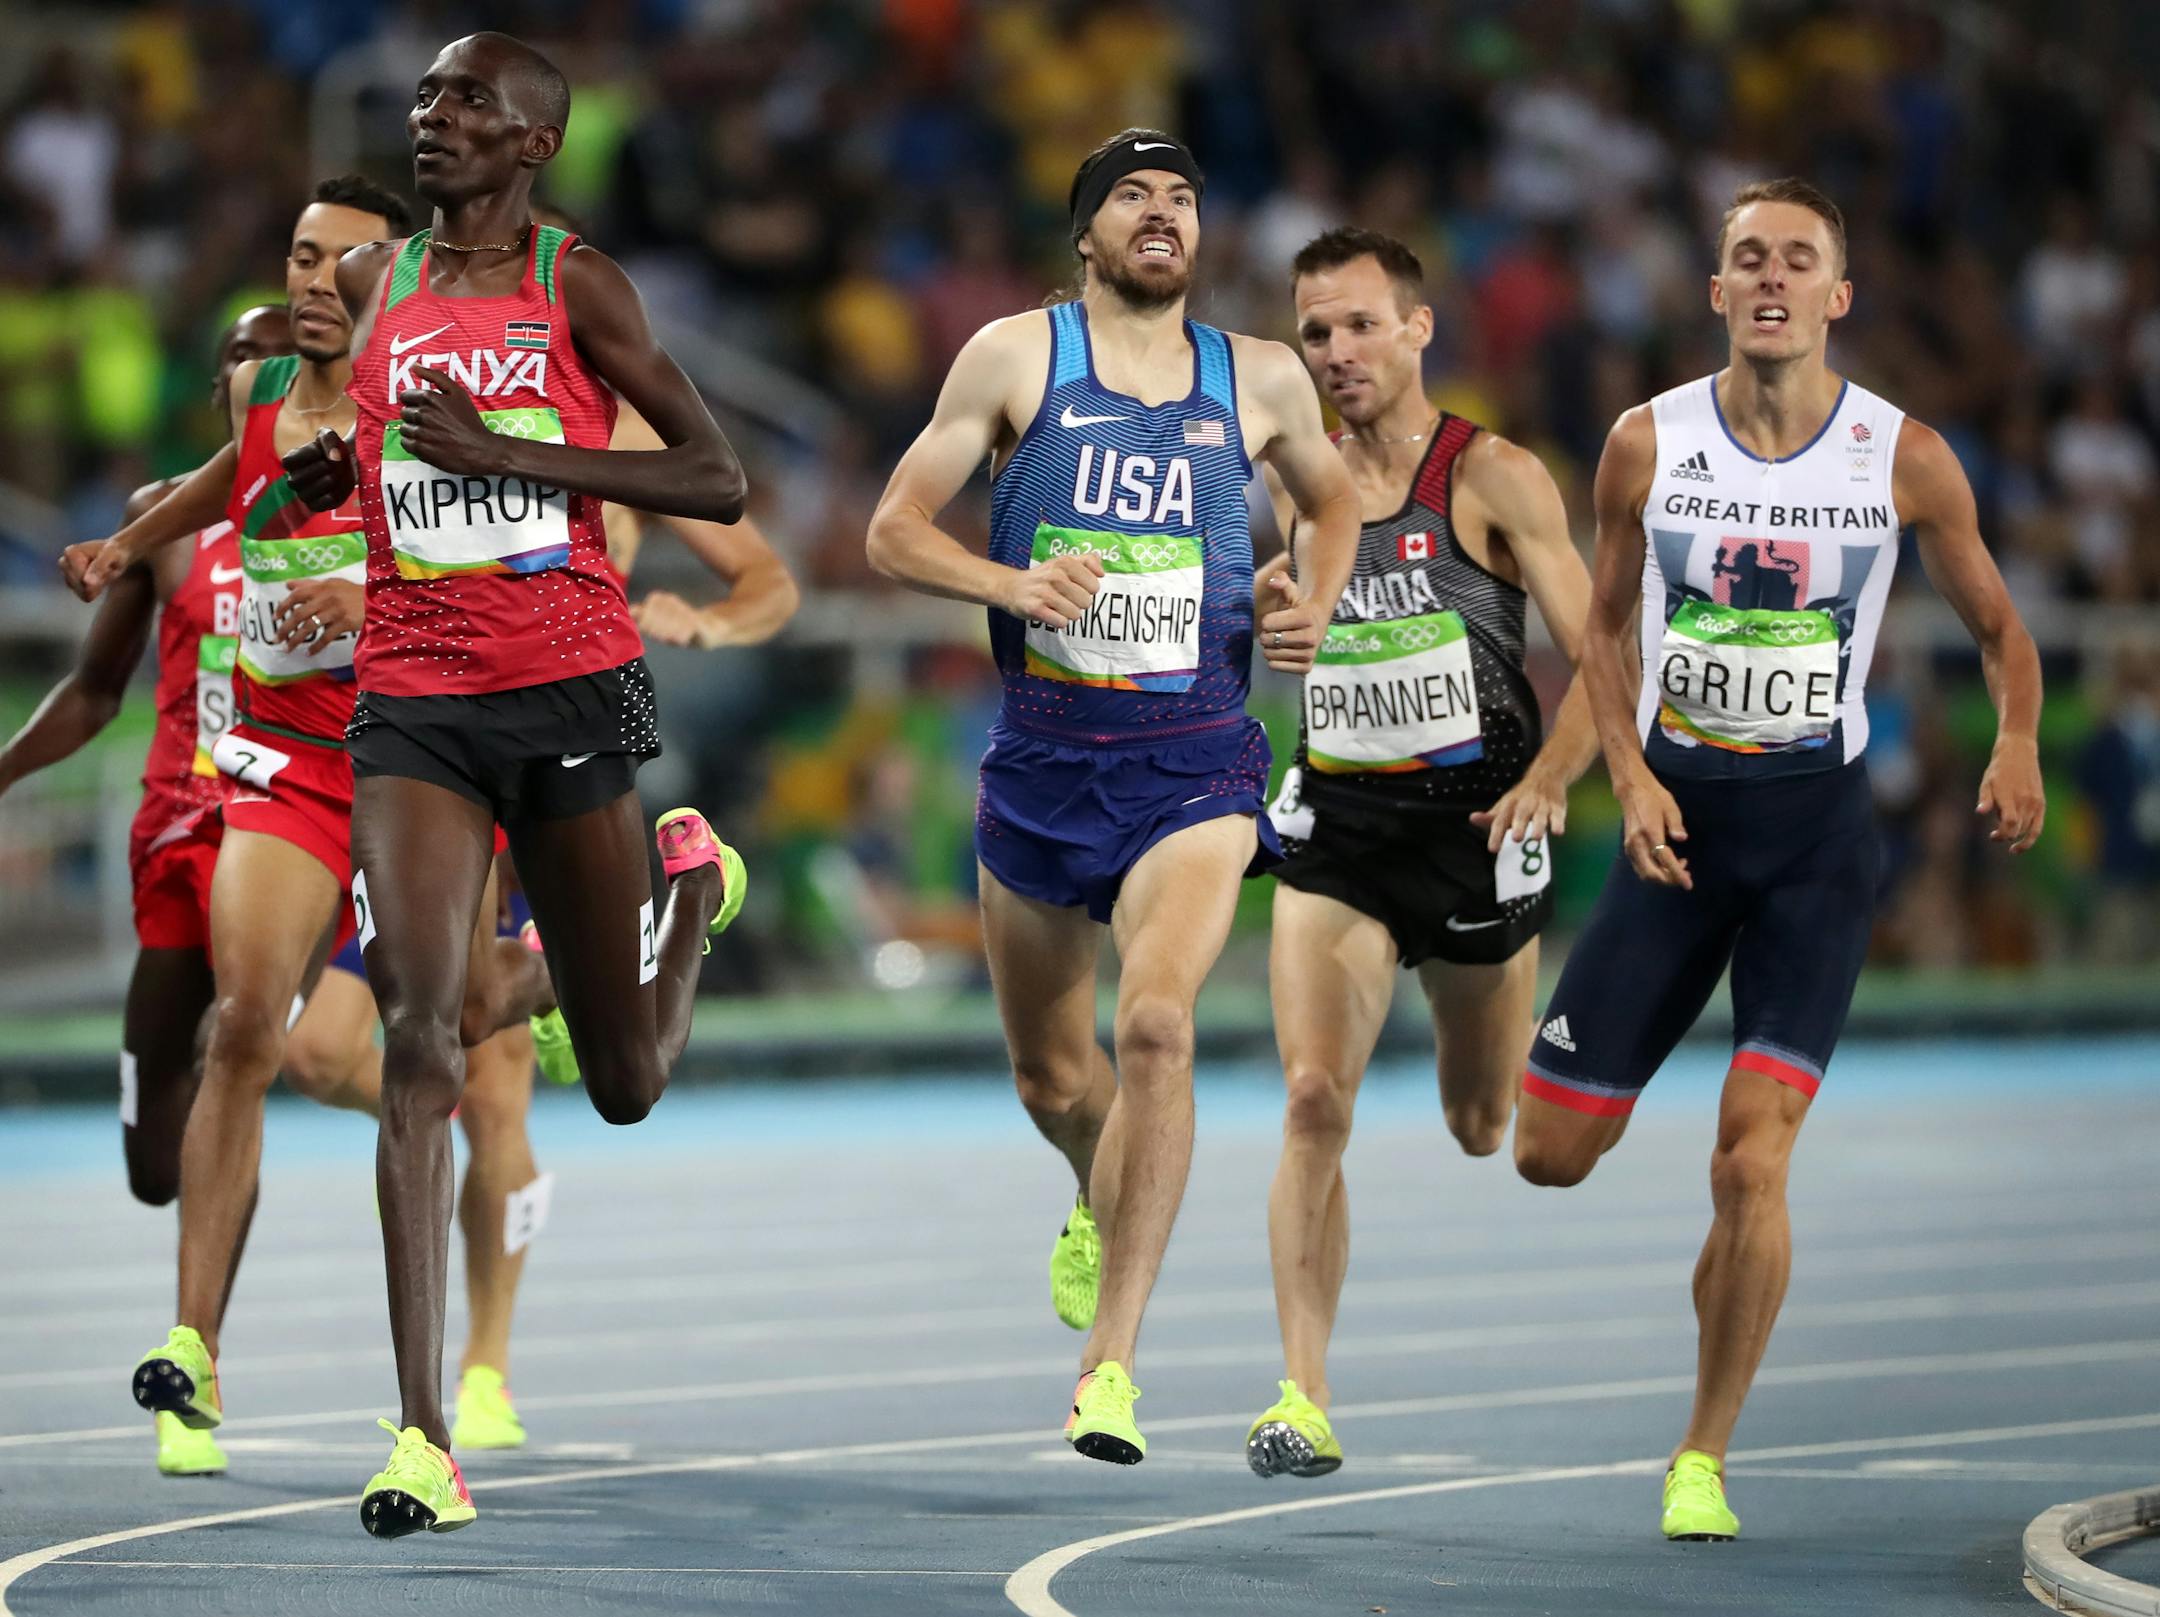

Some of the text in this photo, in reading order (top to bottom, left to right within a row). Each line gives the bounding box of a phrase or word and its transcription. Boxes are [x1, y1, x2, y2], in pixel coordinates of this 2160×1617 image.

[388, 349, 548, 404] KENYA
[1072, 444, 1194, 527] USA
[1671, 468, 1714, 483] adidas
[387, 475, 560, 531] KIPROP
[1664, 493, 1889, 530] GREAT BRITAIN
[1336, 568, 1443, 620] NADA
[1310, 670, 1473, 731] BRANNEN
[1662, 652, 1833, 719] GRICE
[1521, 837, 1543, 876] 8
[1541, 1027, 1576, 1052] adidas
